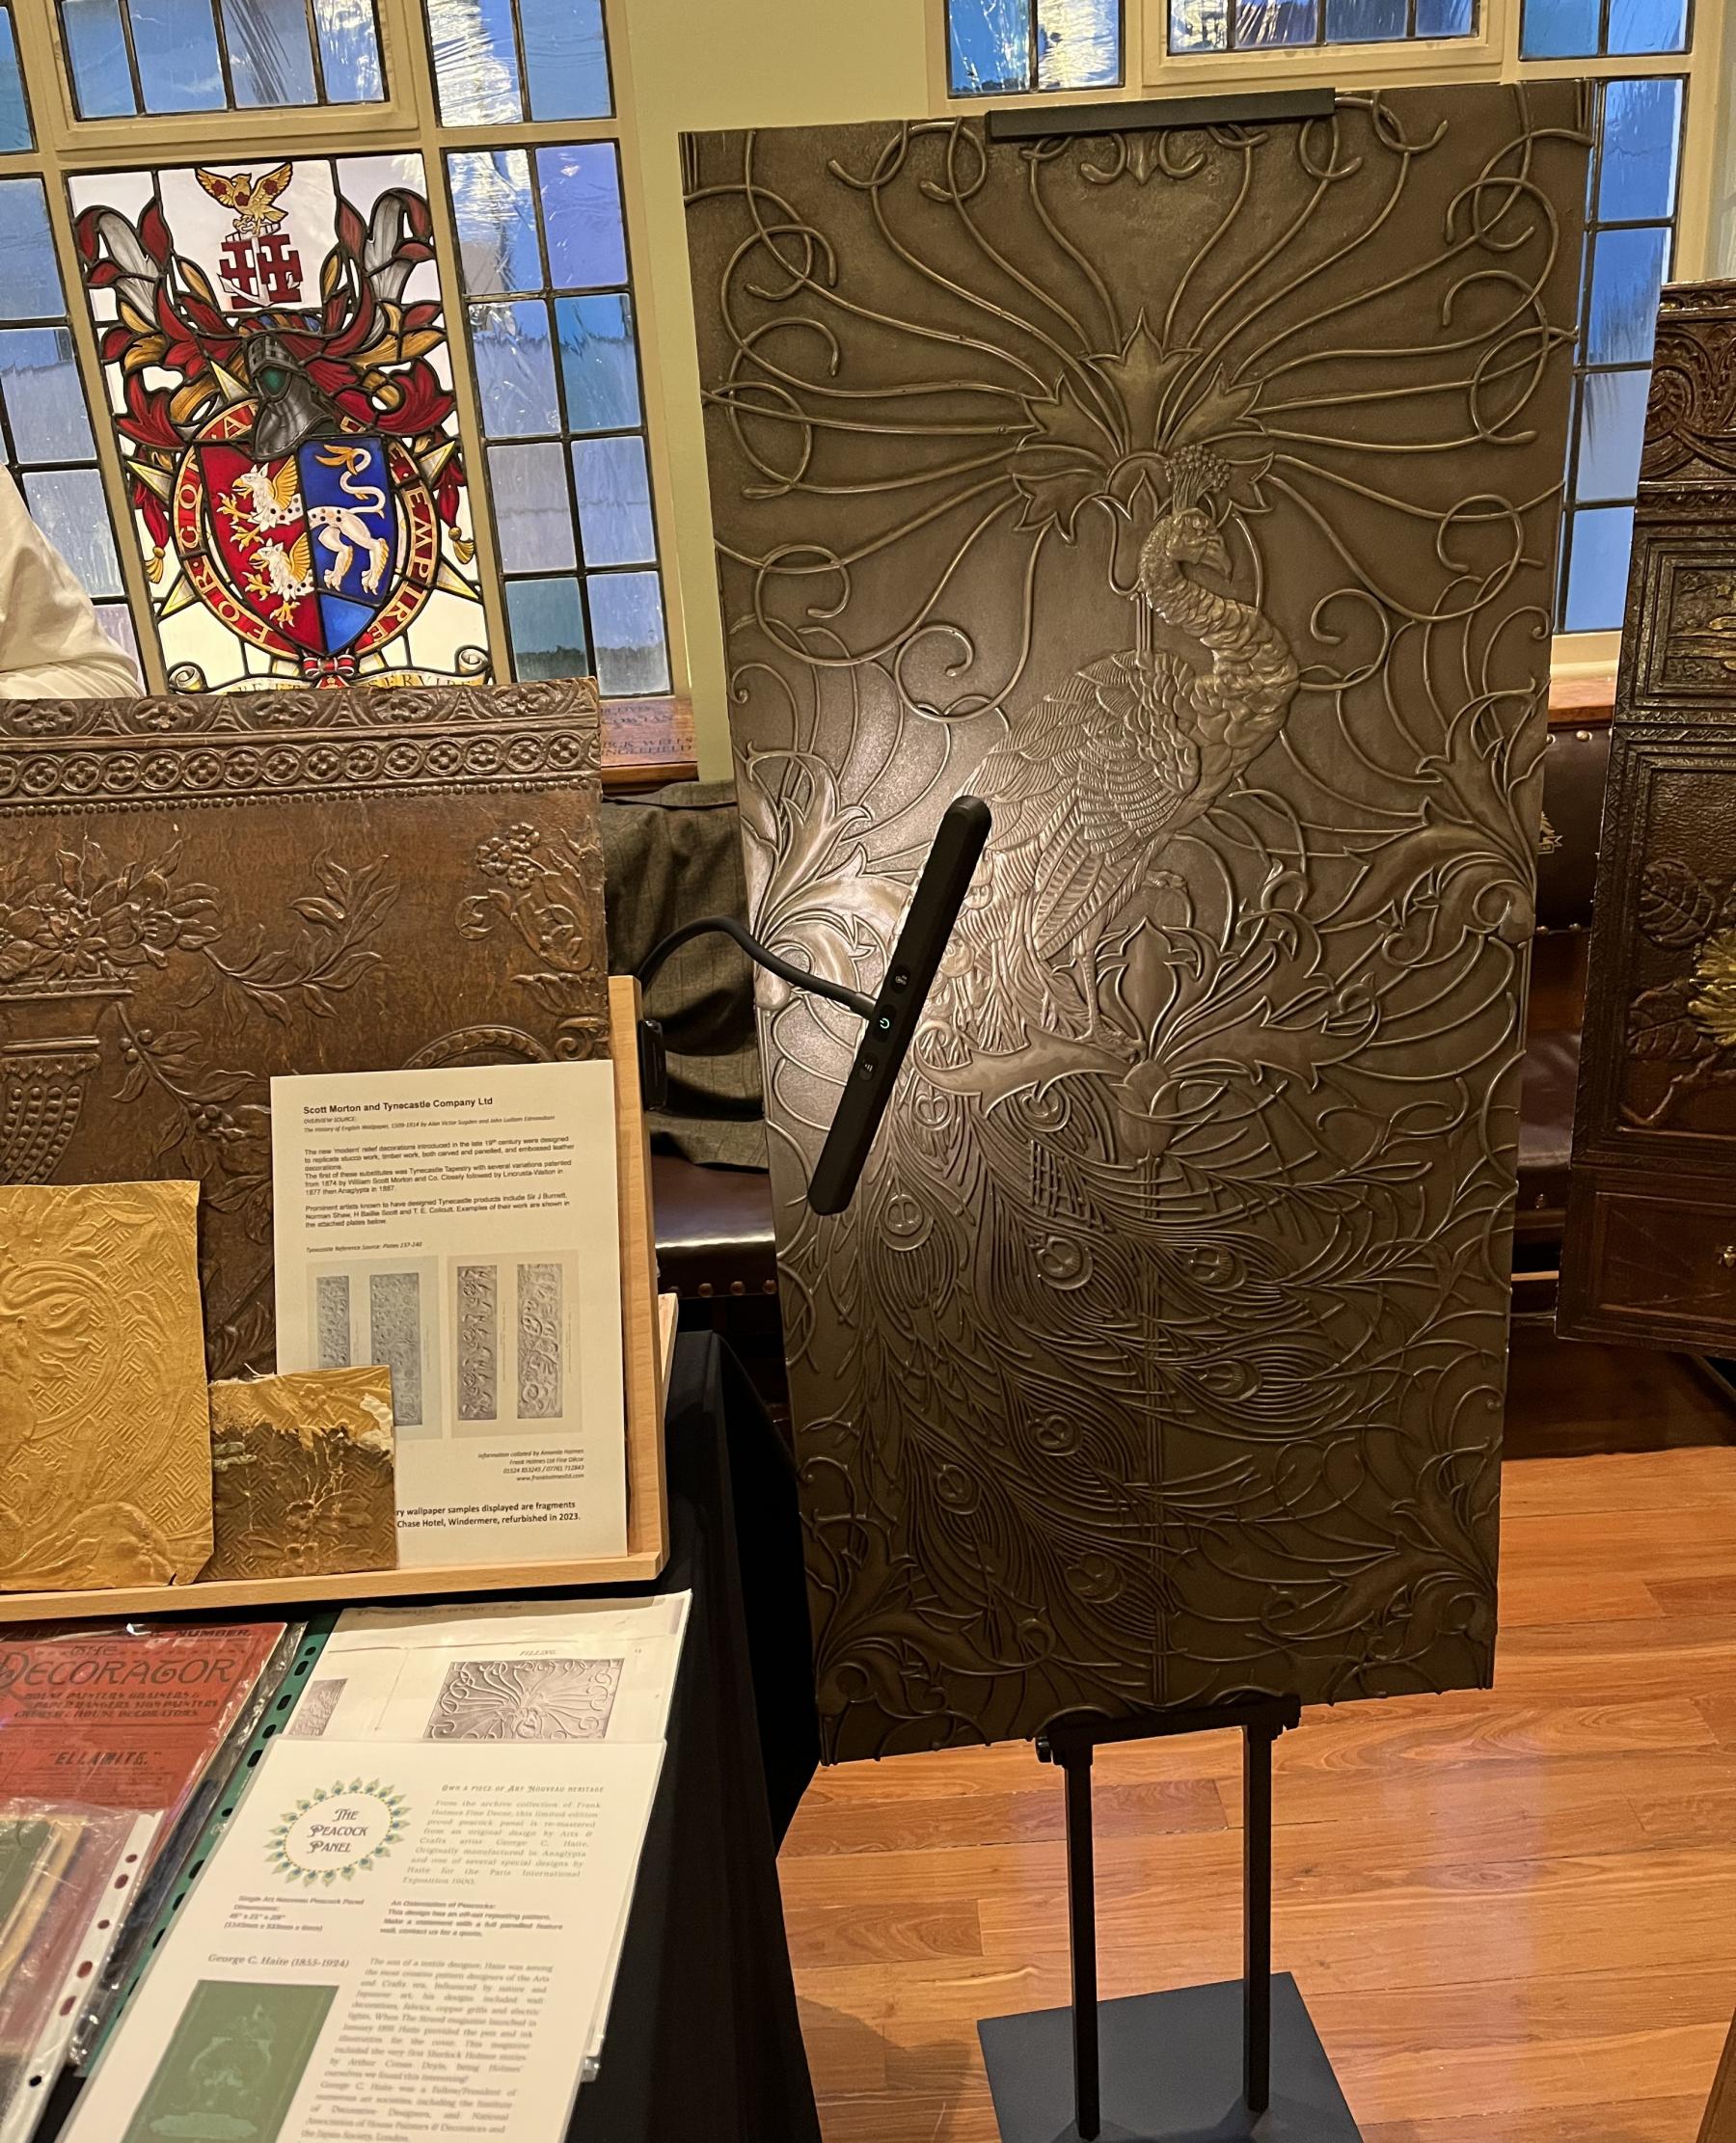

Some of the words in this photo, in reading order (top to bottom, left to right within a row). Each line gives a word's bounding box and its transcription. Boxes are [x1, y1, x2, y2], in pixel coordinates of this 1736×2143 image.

[194, 568, 273, 646] FOR
[368, 488, 431, 644] EMPIRE
[304, 1105, 327, 1115] Scott
[330, 1104, 361, 1113] Morton
[364, 1103, 381, 1112] and
[383, 1100, 431, 1112] Tynecastle
[433, 1099, 475, 1108] Company
[407, 1507, 446, 1517] wallpaper
[448, 1505, 480, 1514] samples
[482, 1504, 519, 1513] displayed
[535, 1501, 576, 1511] fragments
[396, 1520, 420, 1529] Chase
[422, 1519, 447, 1528] Hotel,
[448, 1516, 501, 1526] Windermere,
[502, 1514, 548, 1524] refurbished
[559, 1512, 581, 1522] 2023.
[208, 1954, 245, 1965] George
[247, 1956, 258, 1966] C.
[261, 1957, 289, 1966] Haite
